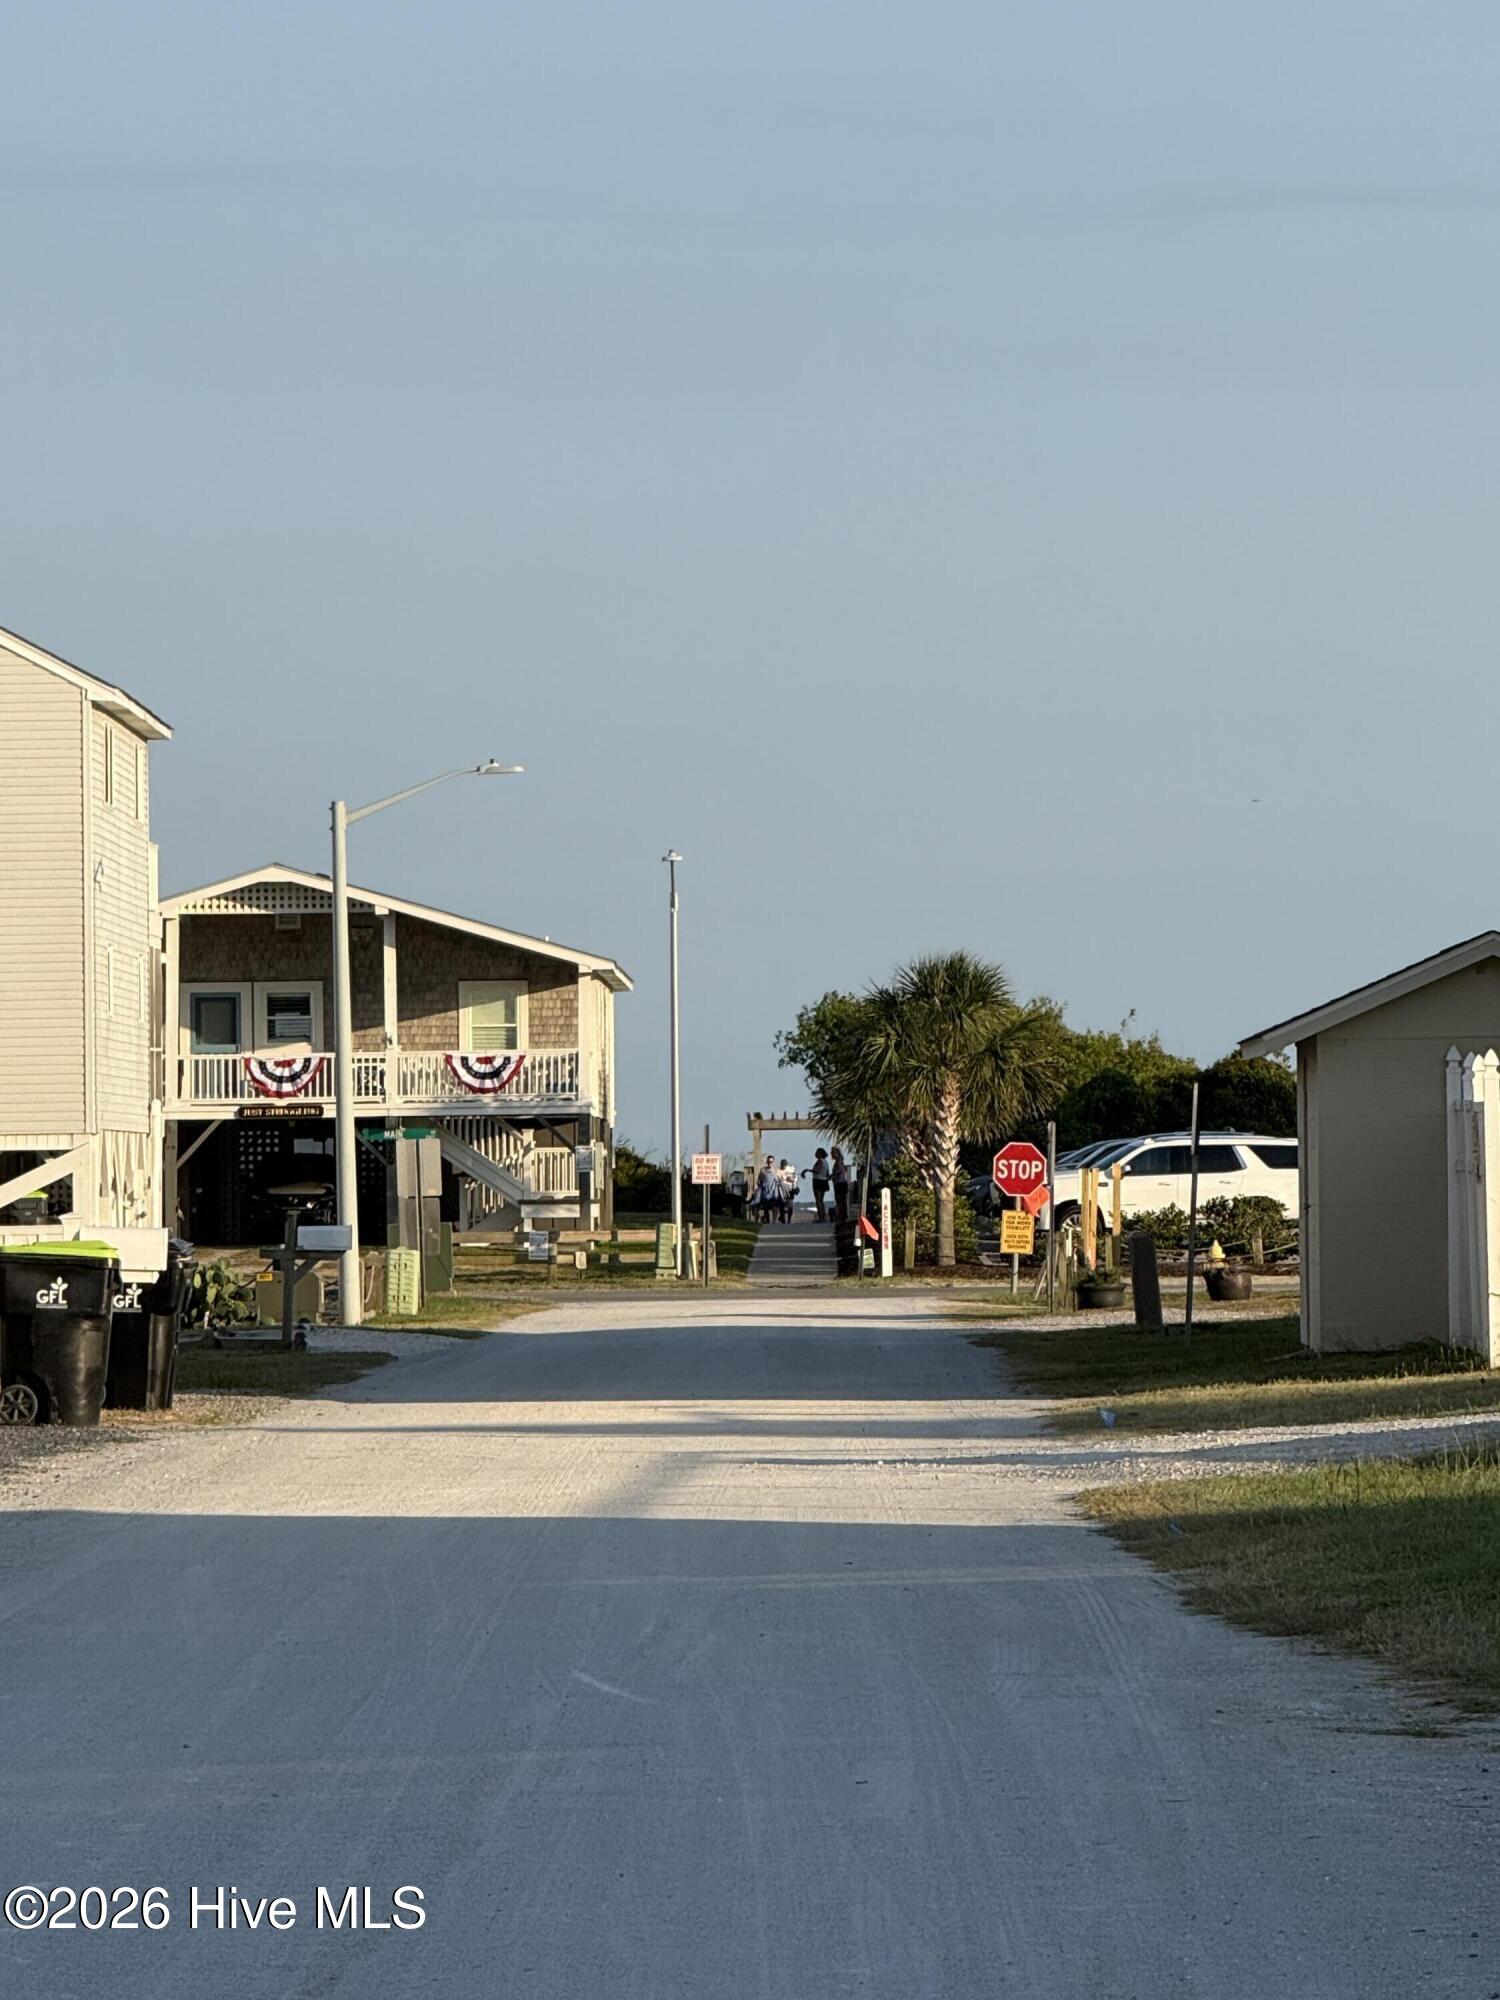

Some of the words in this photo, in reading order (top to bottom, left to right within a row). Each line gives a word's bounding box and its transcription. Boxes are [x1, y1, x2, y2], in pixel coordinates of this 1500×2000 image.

[997, 1160, 1042, 1180] STOP
[36, 1286, 68, 1304] GFL
[113, 1291, 142, 1308] GFL
